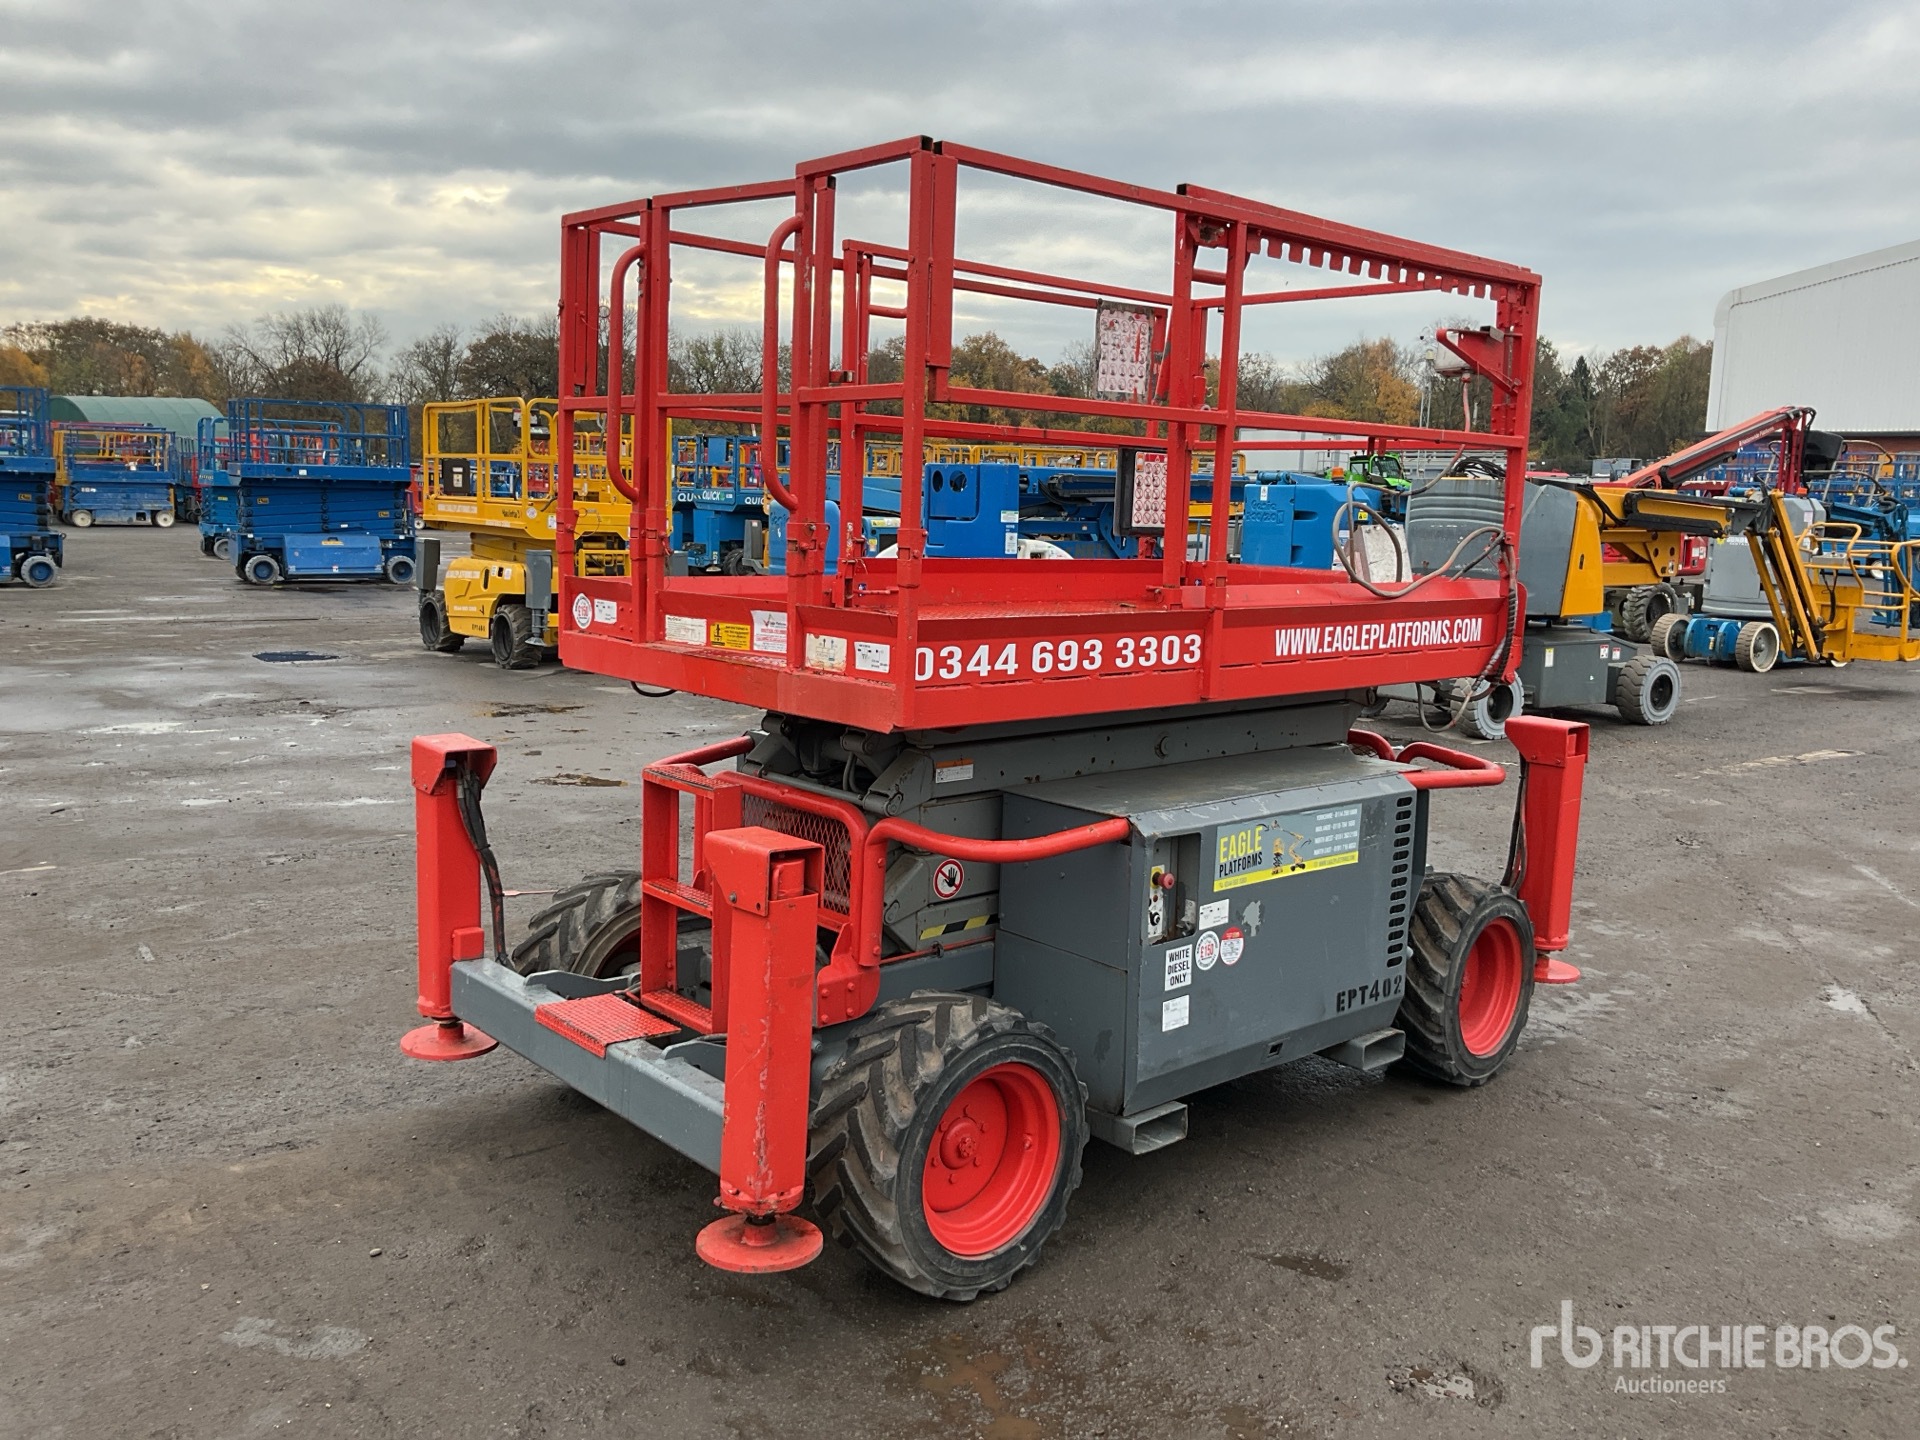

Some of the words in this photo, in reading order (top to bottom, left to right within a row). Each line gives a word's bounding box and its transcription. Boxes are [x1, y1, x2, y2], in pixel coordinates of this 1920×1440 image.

[1275, 617, 1483, 657] WWW.EAGLEPLATFORMS.COM
[915, 643, 1019, 681] 0344
[1031, 639, 1103, 673] 693
[1115, 634, 1202, 669] 3303
[1219, 825, 1263, 864] EAGLE
[1219, 851, 1263, 878] PLATFORMS
[1167, 960, 1190, 975] DIESEL
[1168, 947, 1190, 963] WHITE
[1169, 972, 1188, 986] ONLY
[1336, 974, 1402, 1013] EPT402
